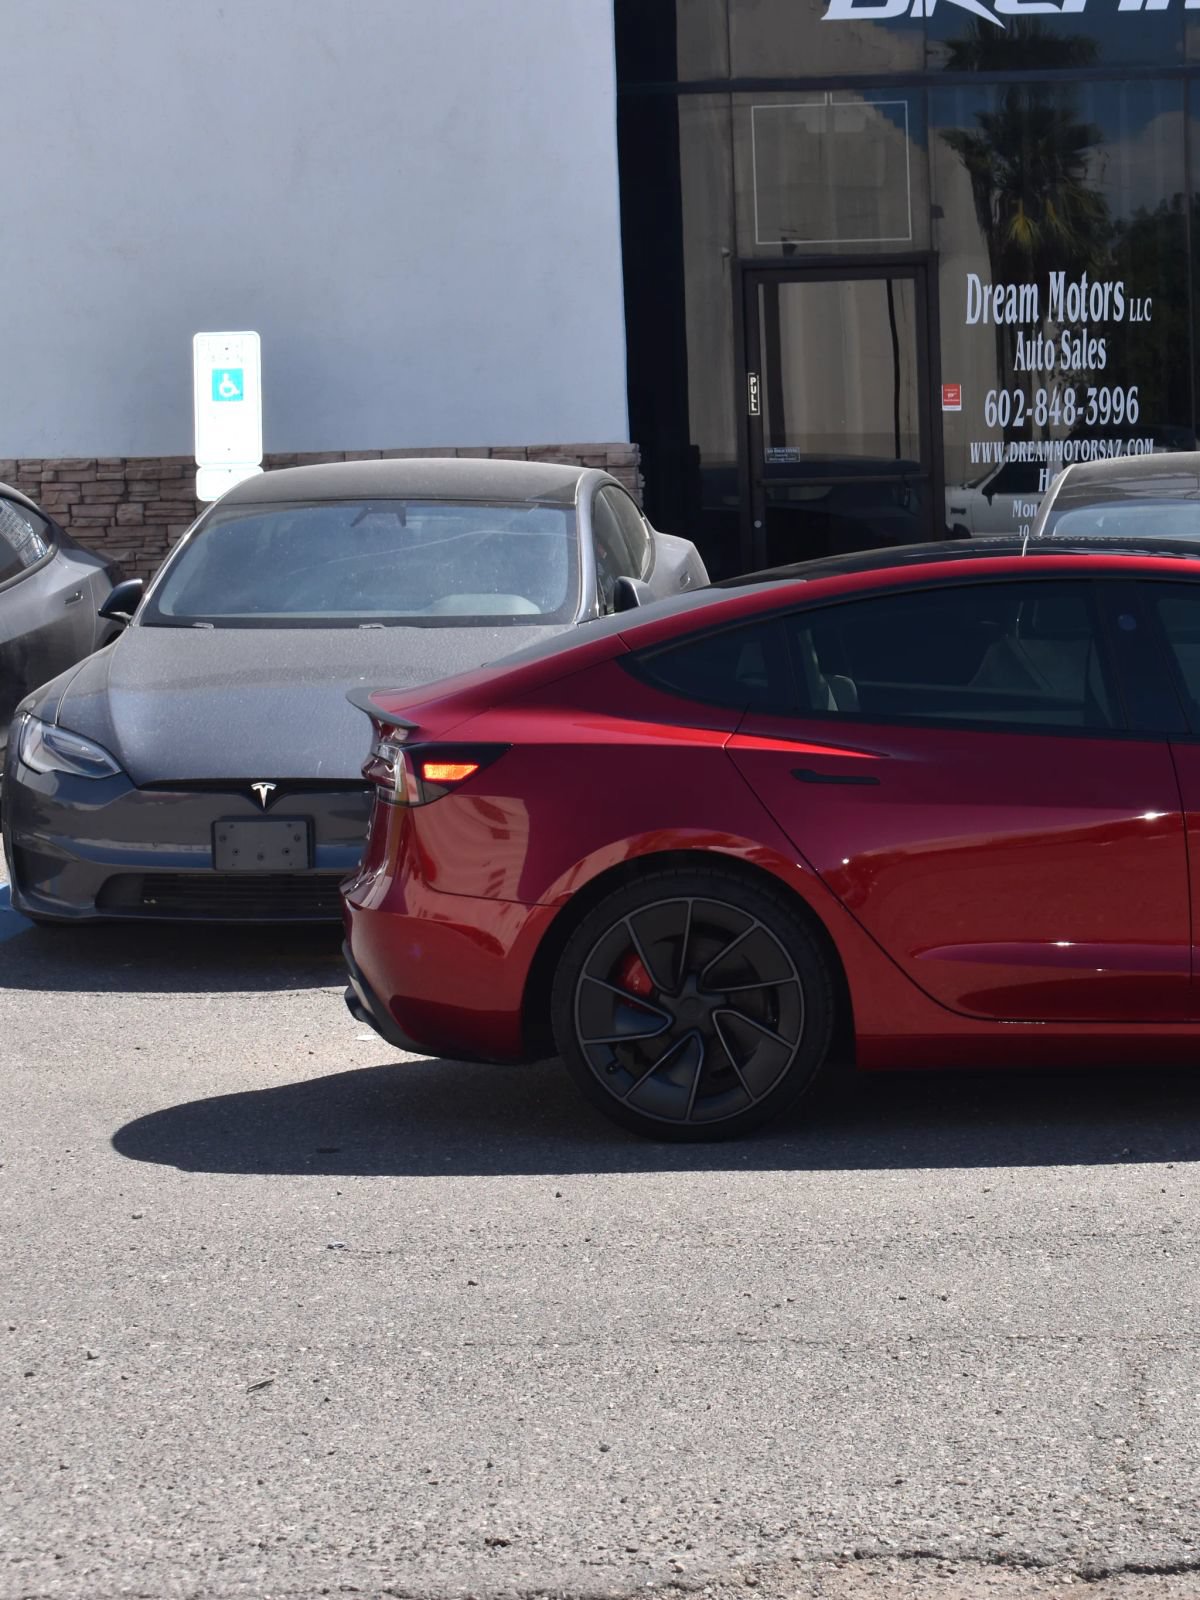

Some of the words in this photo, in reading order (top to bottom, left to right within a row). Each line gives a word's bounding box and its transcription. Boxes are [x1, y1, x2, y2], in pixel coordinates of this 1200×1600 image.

[966, 273, 1039, 324] Dream
[1048, 270, 1125, 322] Motors
[1129, 297, 1152, 322] LLC
[1014, 330, 1055, 371] Auto
[1060, 328, 1107, 370] Sales
[985, 386, 1139, 427] 602-848-3996
[970, 438, 1154, 463] WWW.DREAMMOTORSAZ.COM
